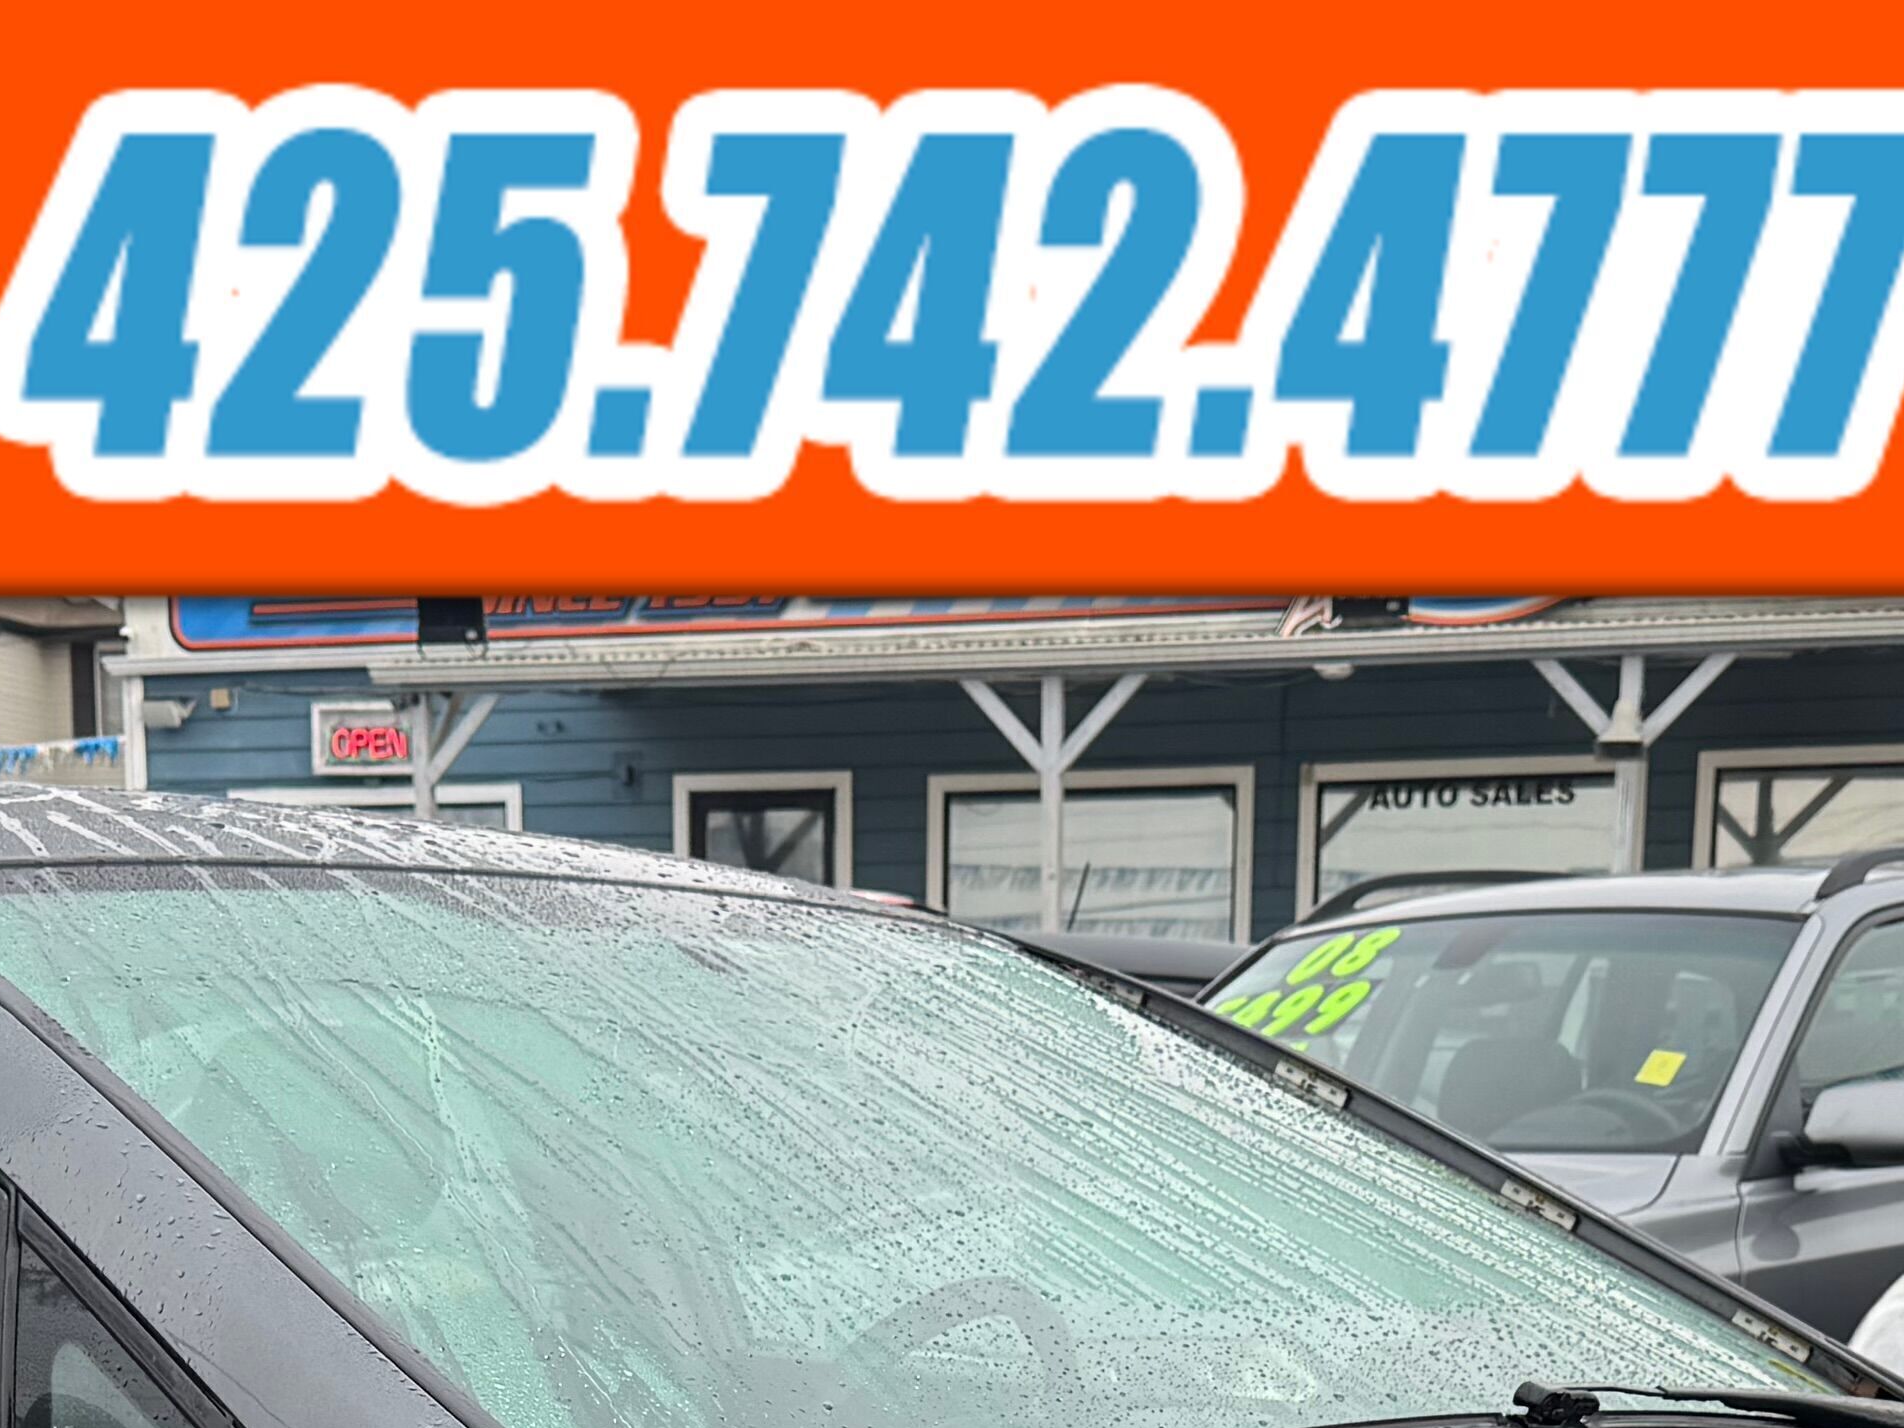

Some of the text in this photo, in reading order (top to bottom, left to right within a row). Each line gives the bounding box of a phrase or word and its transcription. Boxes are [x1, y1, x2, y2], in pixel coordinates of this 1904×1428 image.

[331, 728, 409, 760] OPEN
[1369, 778, 1577, 811] AUTO SALES
[1285, 926, 1401, 986] 08
